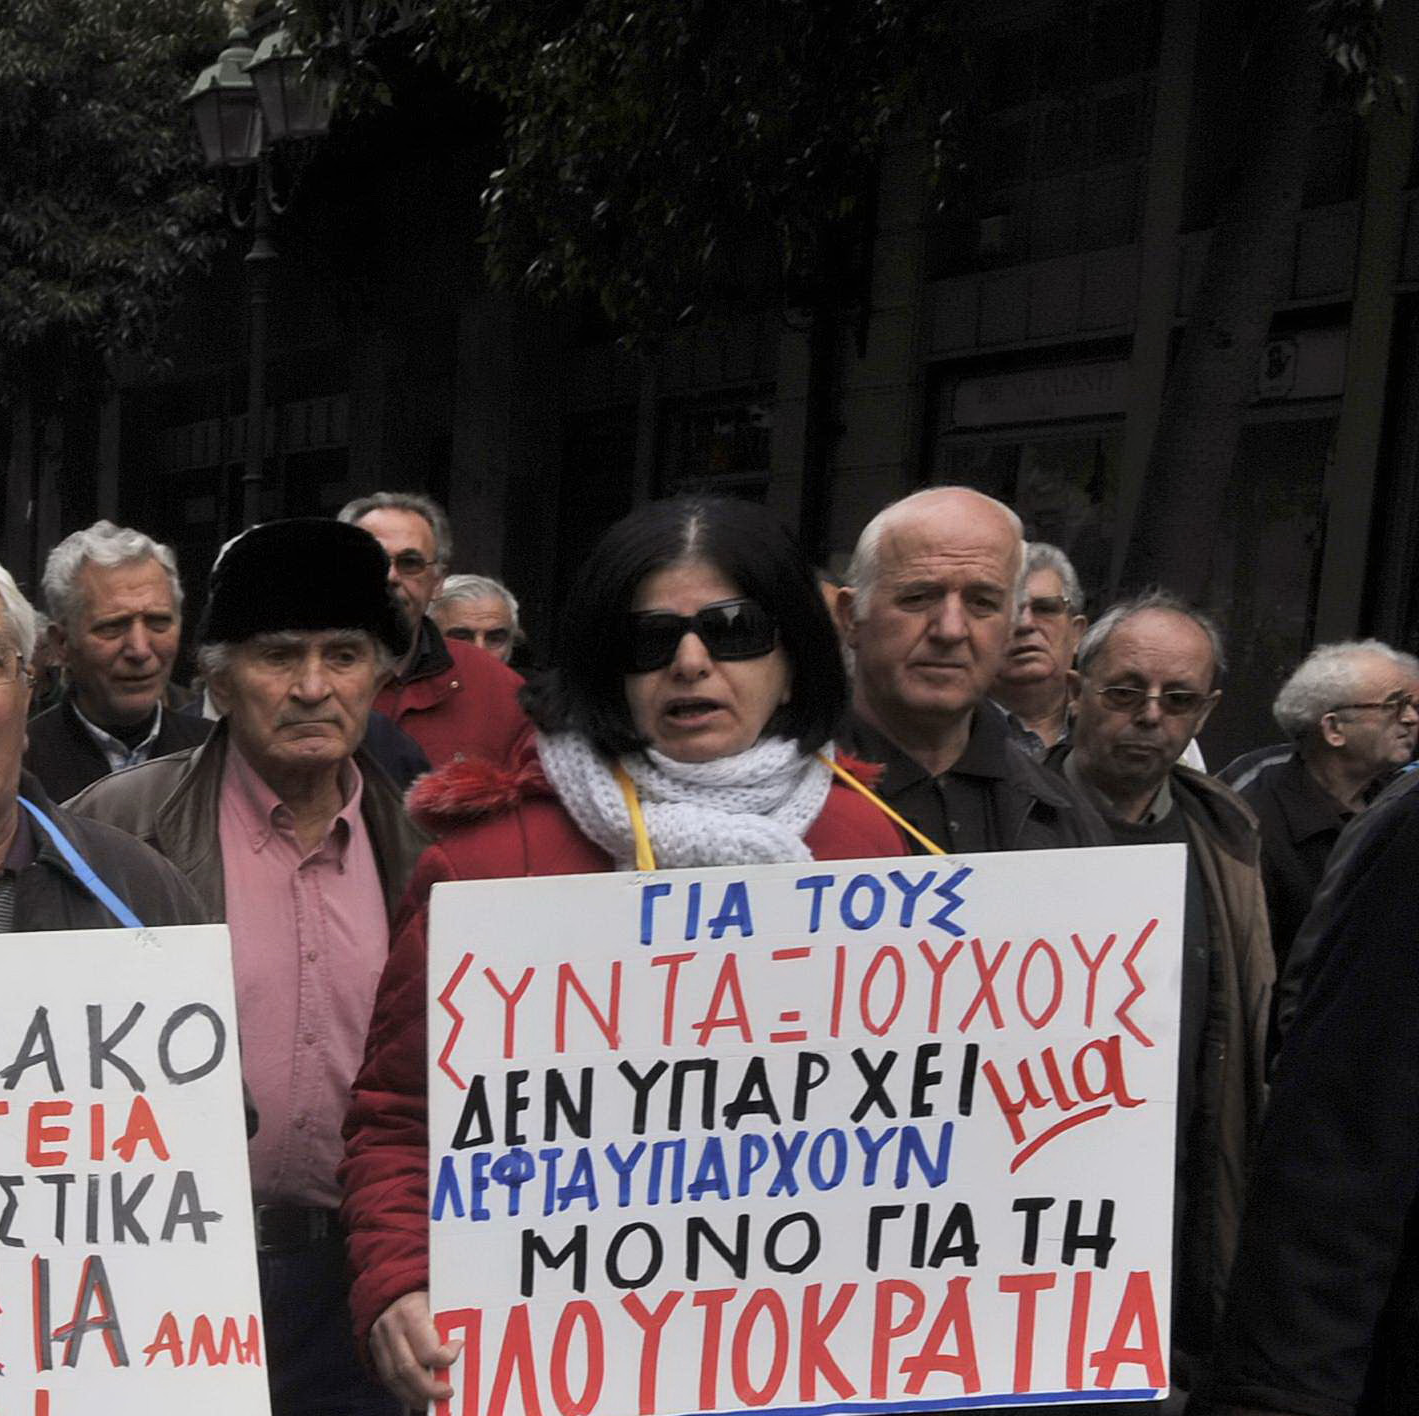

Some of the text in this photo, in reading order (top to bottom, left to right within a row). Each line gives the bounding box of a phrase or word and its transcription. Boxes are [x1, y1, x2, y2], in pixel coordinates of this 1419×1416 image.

[639, 866, 974, 946] ΓΙΑ ΤΟΥΣ
[437, 918, 1159, 1089] ΣΥΝΤΑΞΙΟΥΧΟΥΣ
[451, 1066, 594, 1151] ΔΕΝ
[618, 1042, 980, 1136] ΥΠΑΡΧΕΙ
[604, 1121, 955, 1209] ΥΠΑΡΧΟΥΝ
[521, 1196, 1117, 1297] ΜΟΝΟ ΓΙΑ ΤΗ
